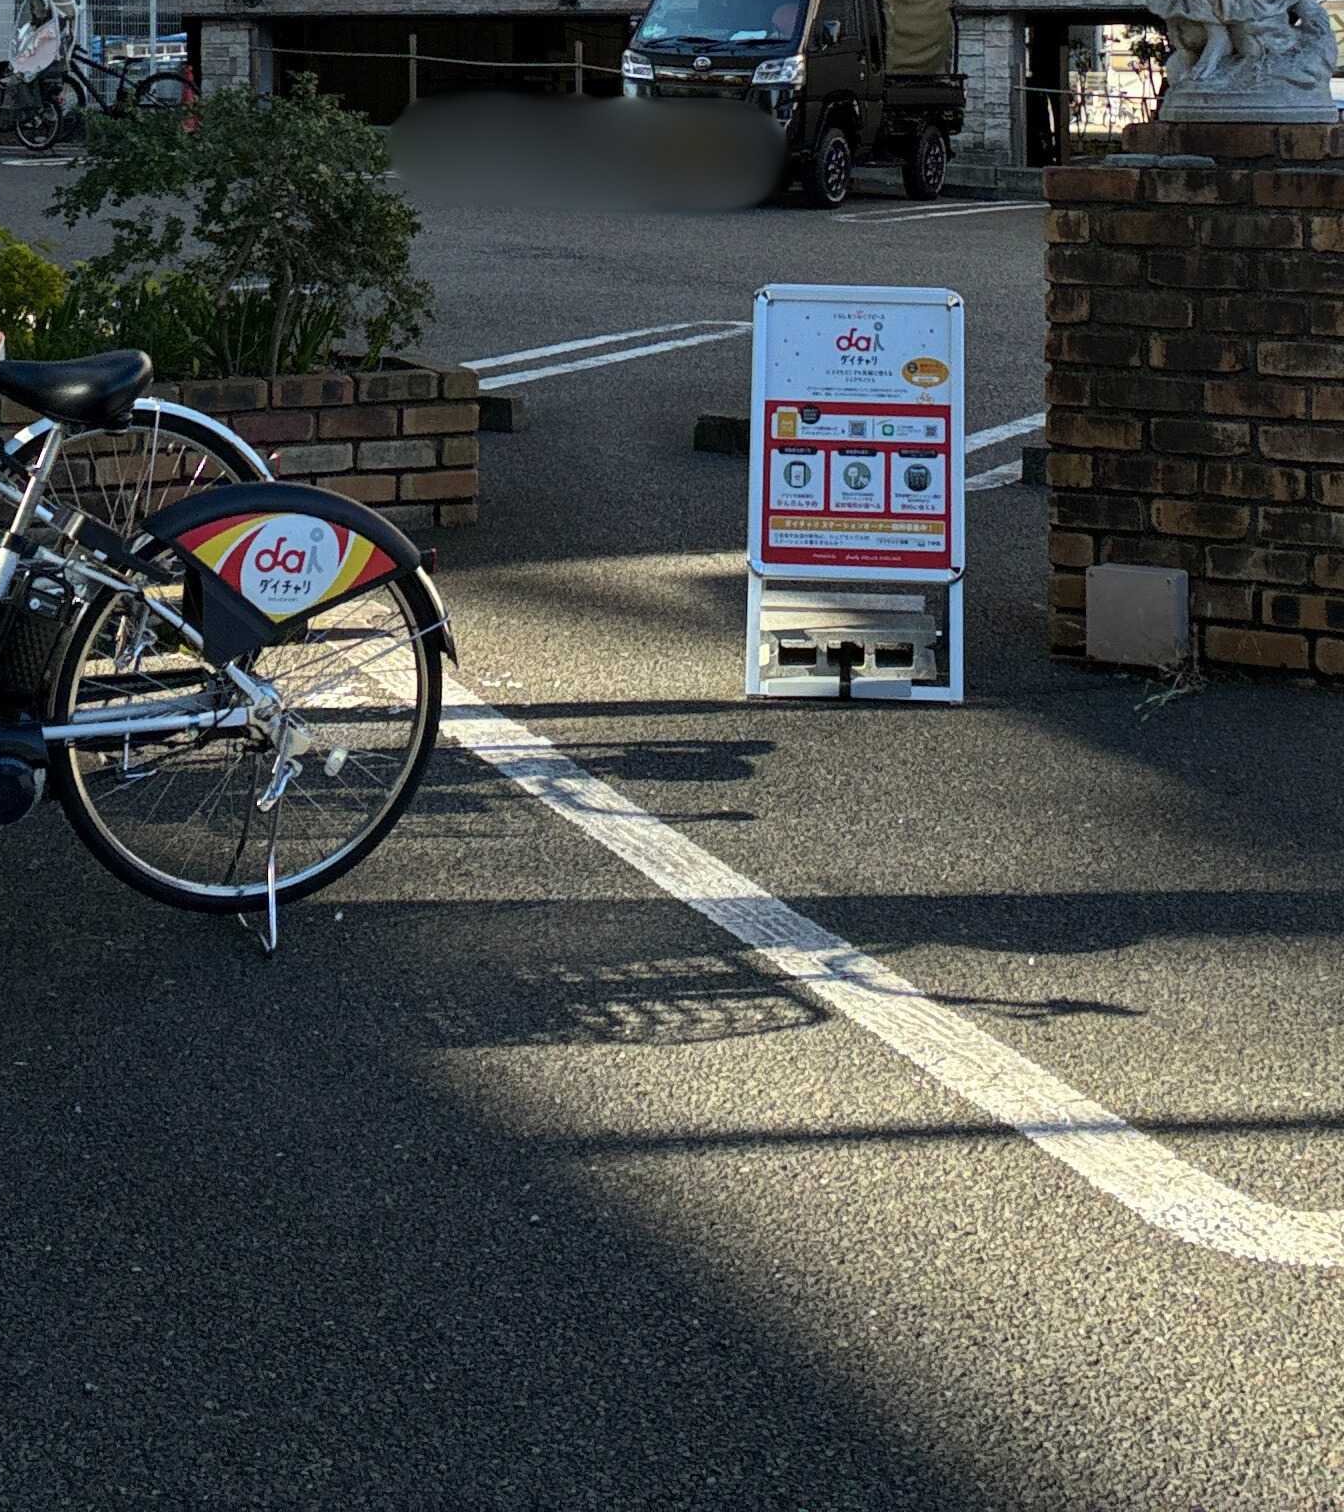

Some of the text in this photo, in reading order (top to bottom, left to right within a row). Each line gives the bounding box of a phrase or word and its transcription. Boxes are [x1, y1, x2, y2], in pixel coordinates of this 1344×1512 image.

[836, 321, 886, 353] dai
[840, 355, 879, 366] ダイチャリ
[255, 527, 324, 574] dai
[259, 578, 311, 595] ダイチャリ
